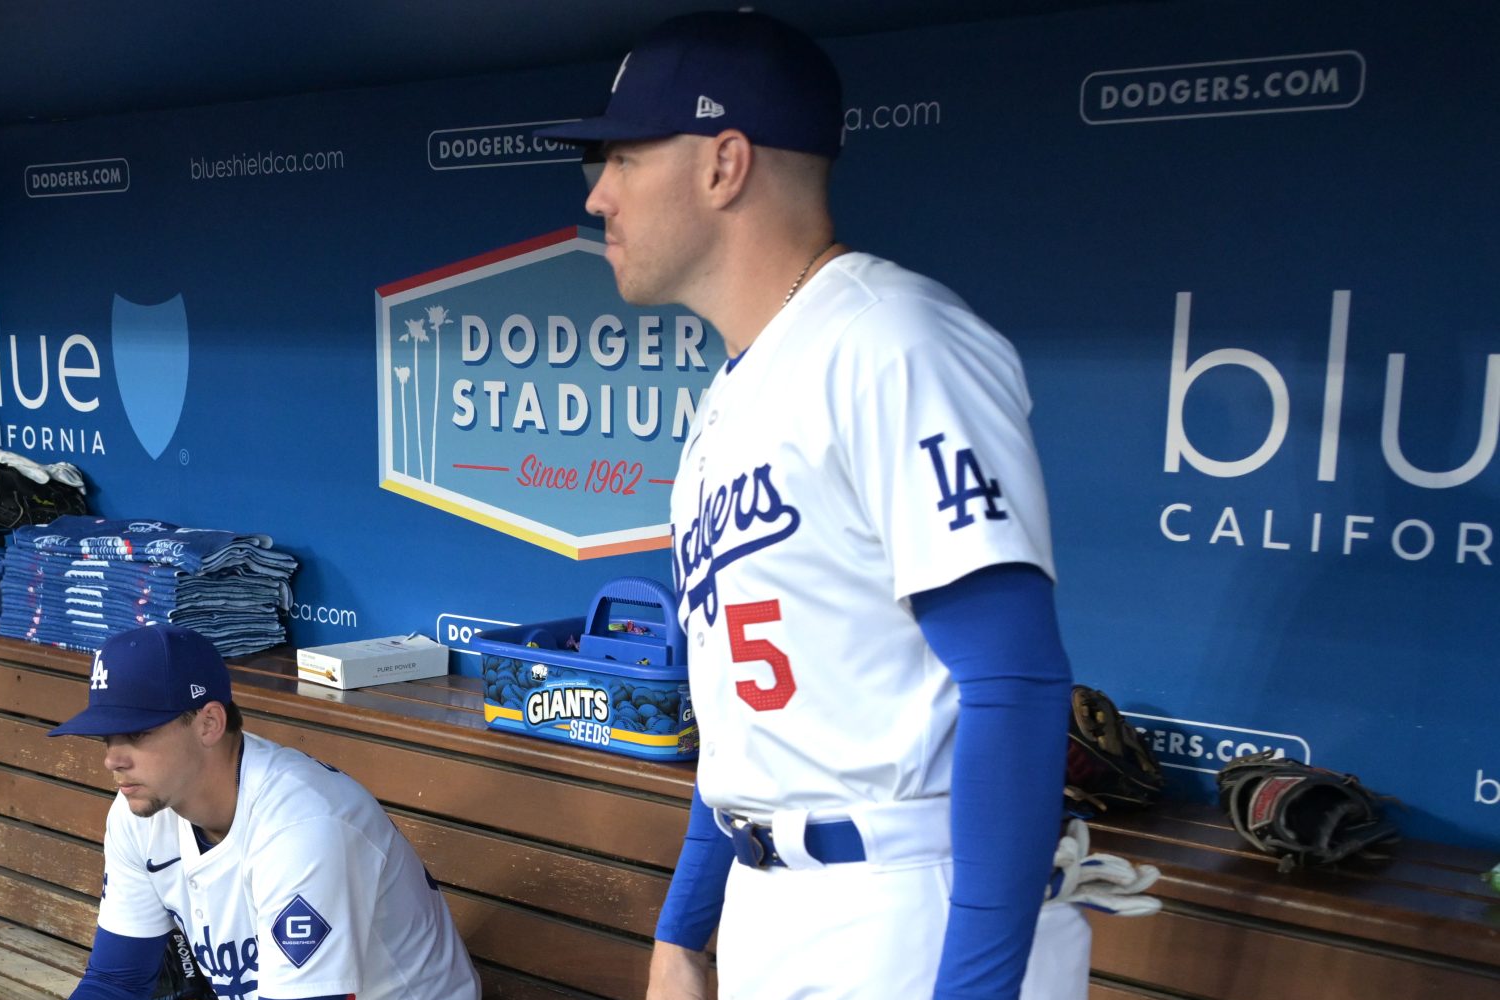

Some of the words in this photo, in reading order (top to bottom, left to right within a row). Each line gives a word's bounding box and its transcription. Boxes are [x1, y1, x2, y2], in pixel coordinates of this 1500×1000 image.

[1099, 67, 1341, 110] DODGERS.COM
[31, 167, 122, 190] DODGERS.COM
[190, 150, 345, 181] blueshieldca.com
[461, 313, 710, 368] DODGER
[516, 453, 579, 492] Since
[584, 460, 645, 495] 1962
[918, 432, 1009, 531] LA
[1160, 502, 1494, 565] CALIFOR
[91, 649, 109, 690] LA
[377, 664, 394, 673] PURE
[394, 662, 417, 671] POWER
[725, 598, 797, 712] 5
[527, 688, 609, 724] GIANTS
[569, 719, 611, 745] SEEDS
[286, 915, 312, 938] G
